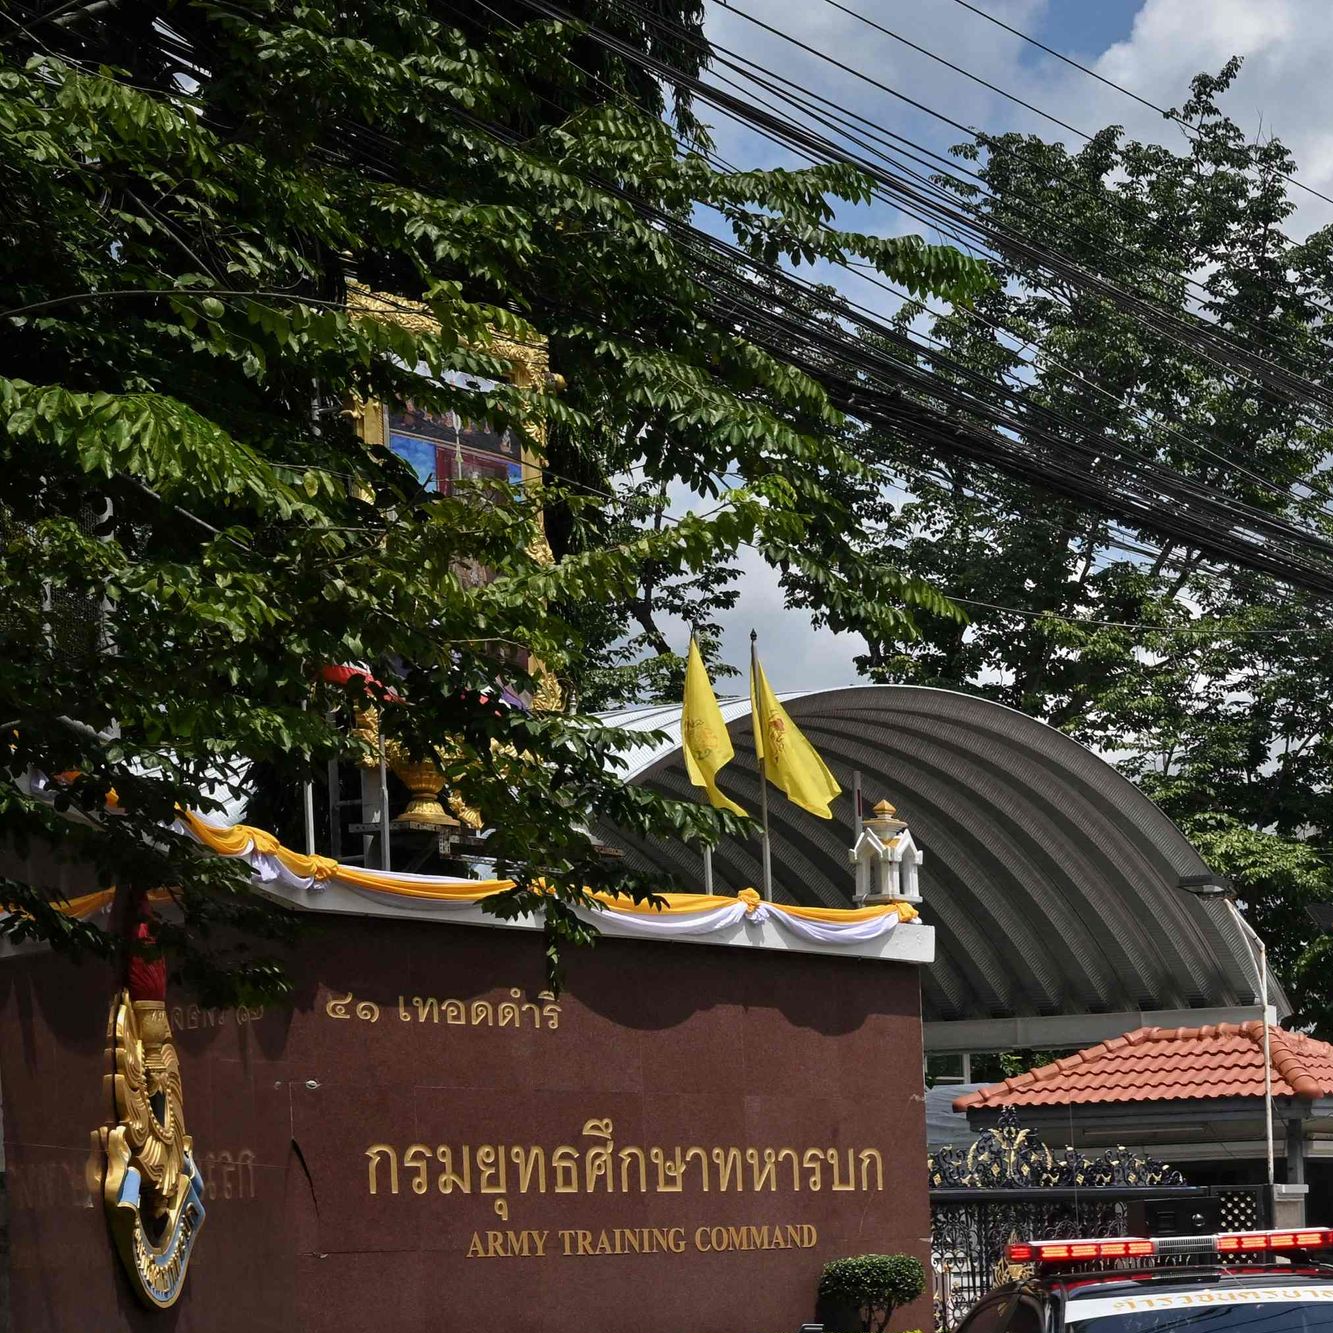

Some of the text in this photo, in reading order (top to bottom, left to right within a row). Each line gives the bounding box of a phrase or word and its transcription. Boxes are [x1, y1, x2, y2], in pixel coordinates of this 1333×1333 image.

[326, 987, 562, 1029] ๔๑ เทอดดำริ
[364, 1117, 885, 1221] กรมยุทธศึกษาทหารบก
[466, 1223, 819, 1258] ARMY TRAINING COMMAND
